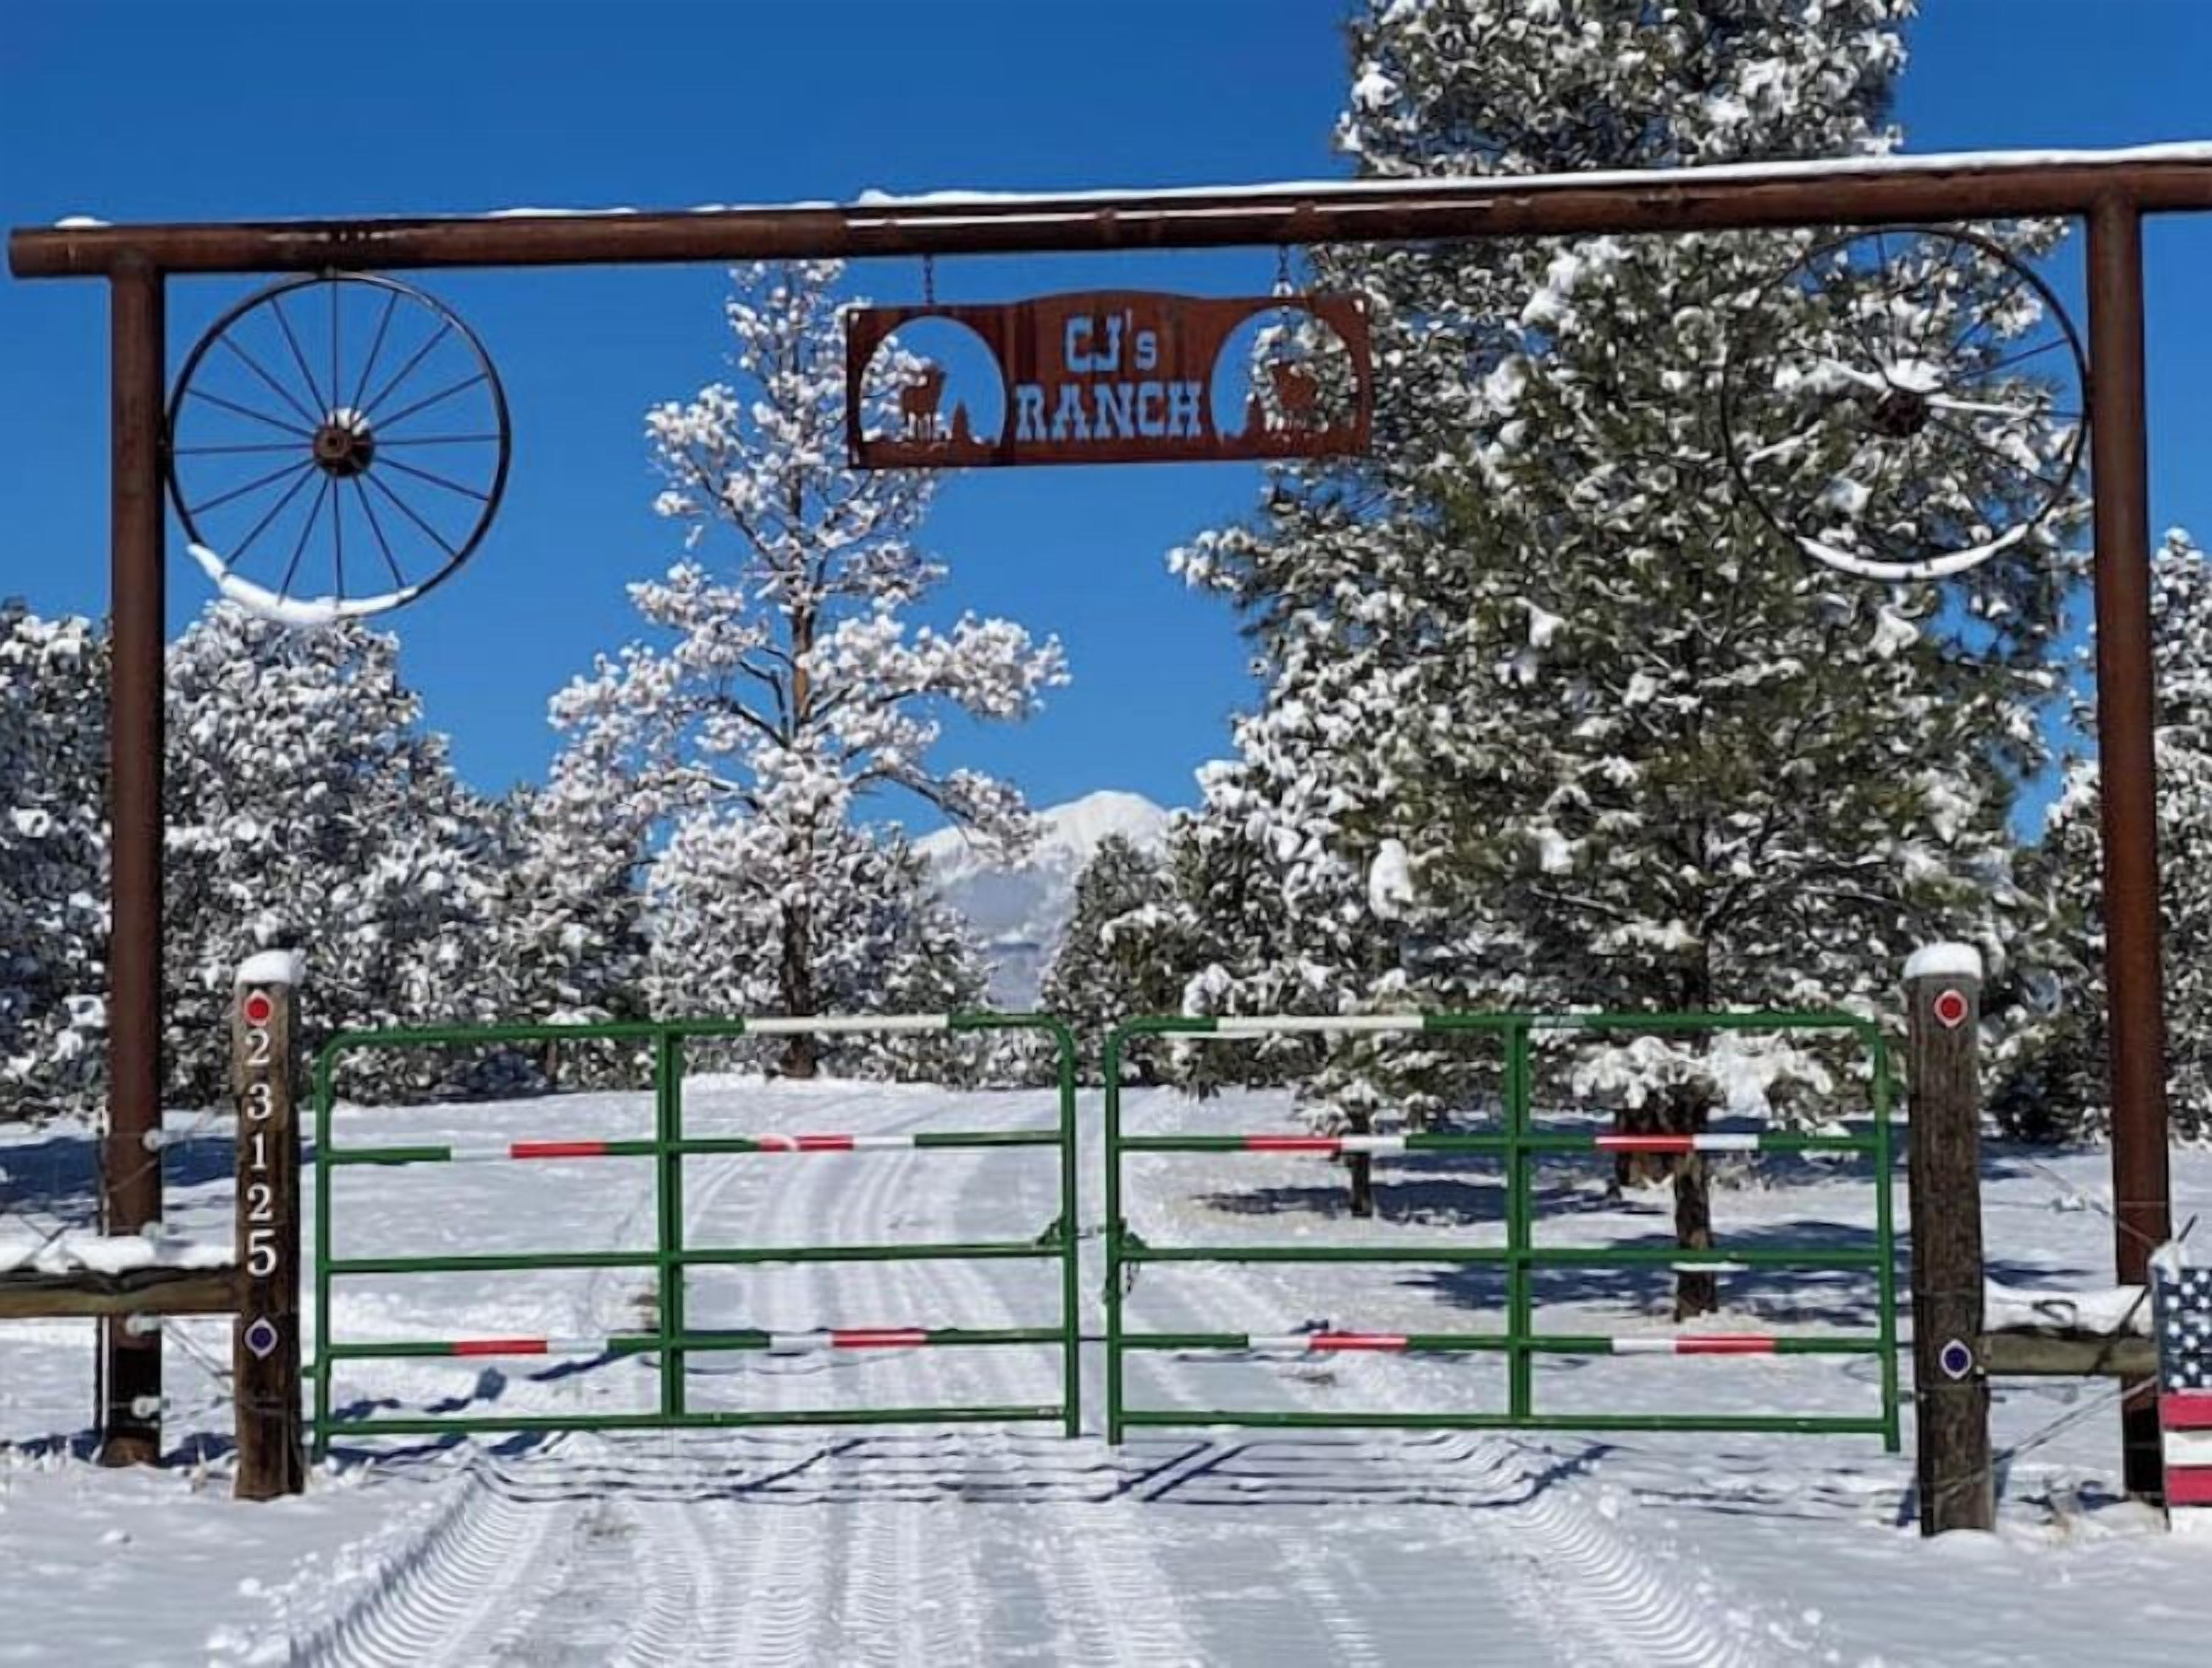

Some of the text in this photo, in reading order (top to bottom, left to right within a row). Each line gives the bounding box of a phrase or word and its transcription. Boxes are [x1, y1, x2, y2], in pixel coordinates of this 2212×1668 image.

[1066, 310, 1157, 372] CJ's
[1015, 382, 1202, 441] RANCH
[246, 1029, 276, 1275] 23125
